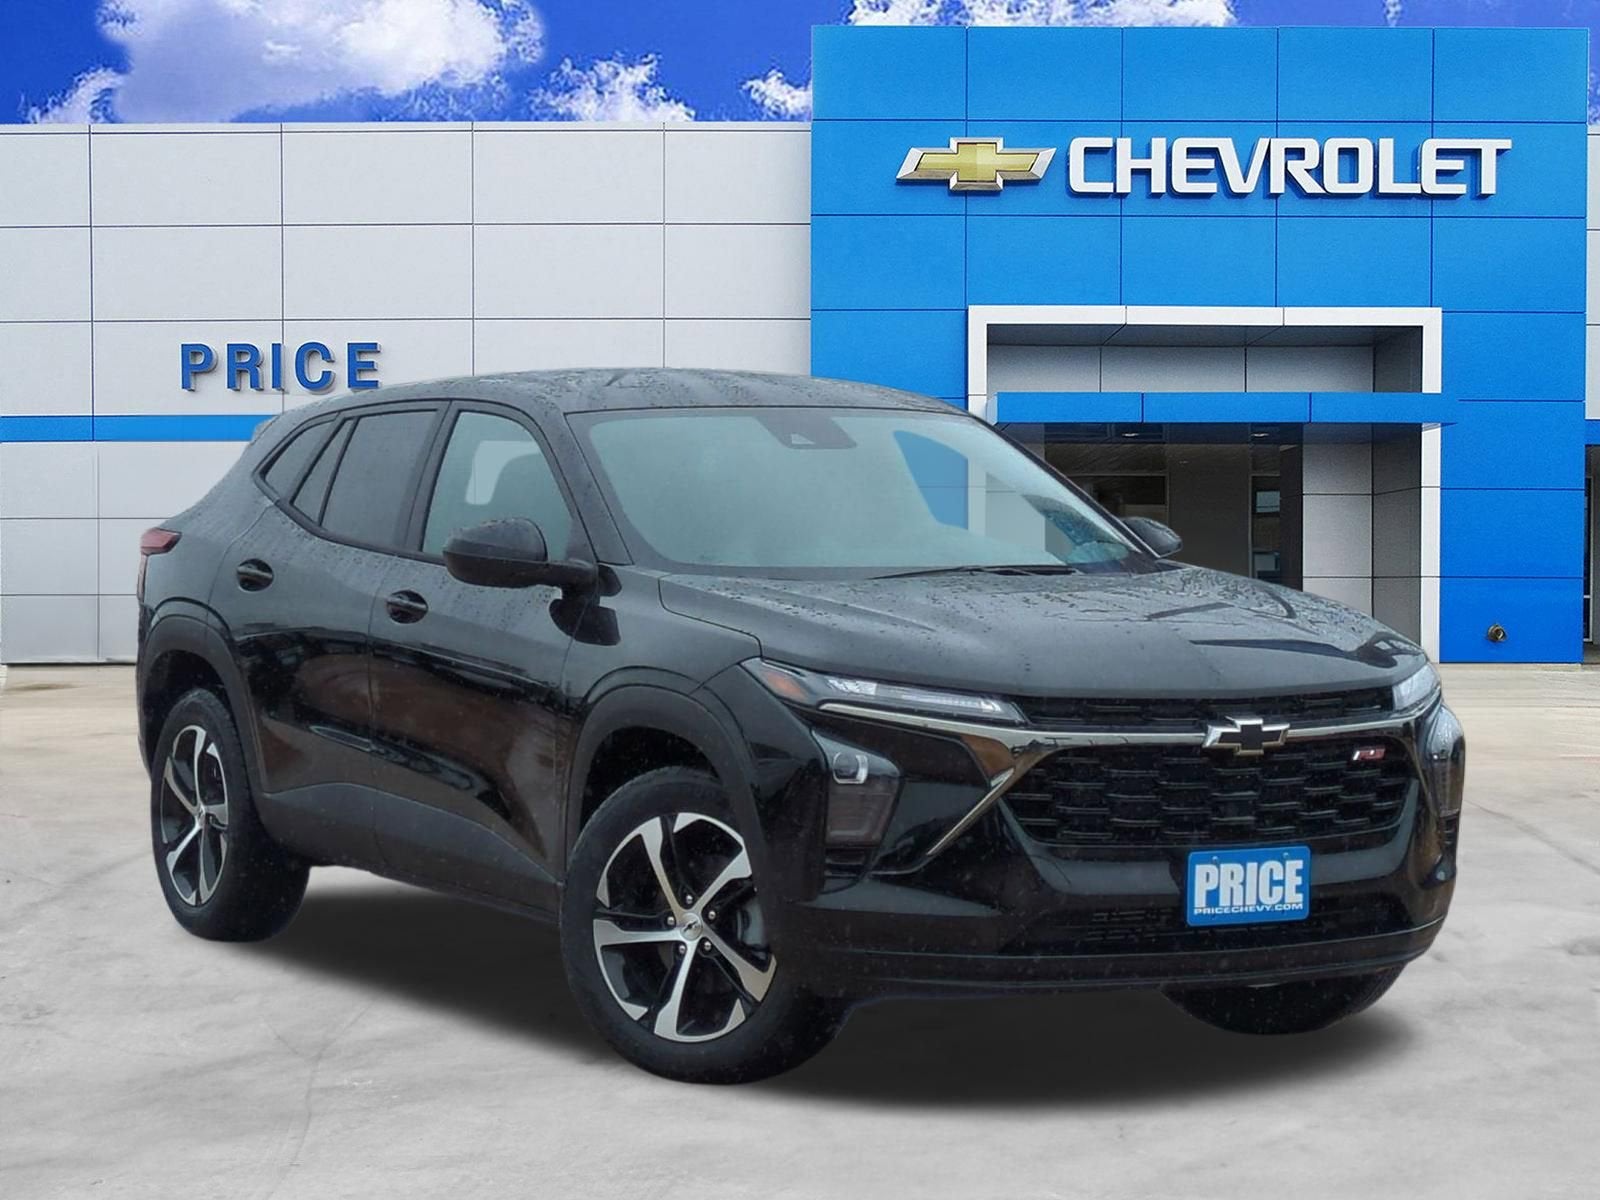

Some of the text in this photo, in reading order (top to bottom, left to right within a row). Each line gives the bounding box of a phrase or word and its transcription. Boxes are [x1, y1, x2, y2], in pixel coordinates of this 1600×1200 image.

[1069, 137, 1512, 195] CHEVROLET
[180, 342, 381, 393] PRICE
[1194, 860, 1304, 907] PRICE
[1194, 903, 1304, 915] PRICECHEVY.COM
